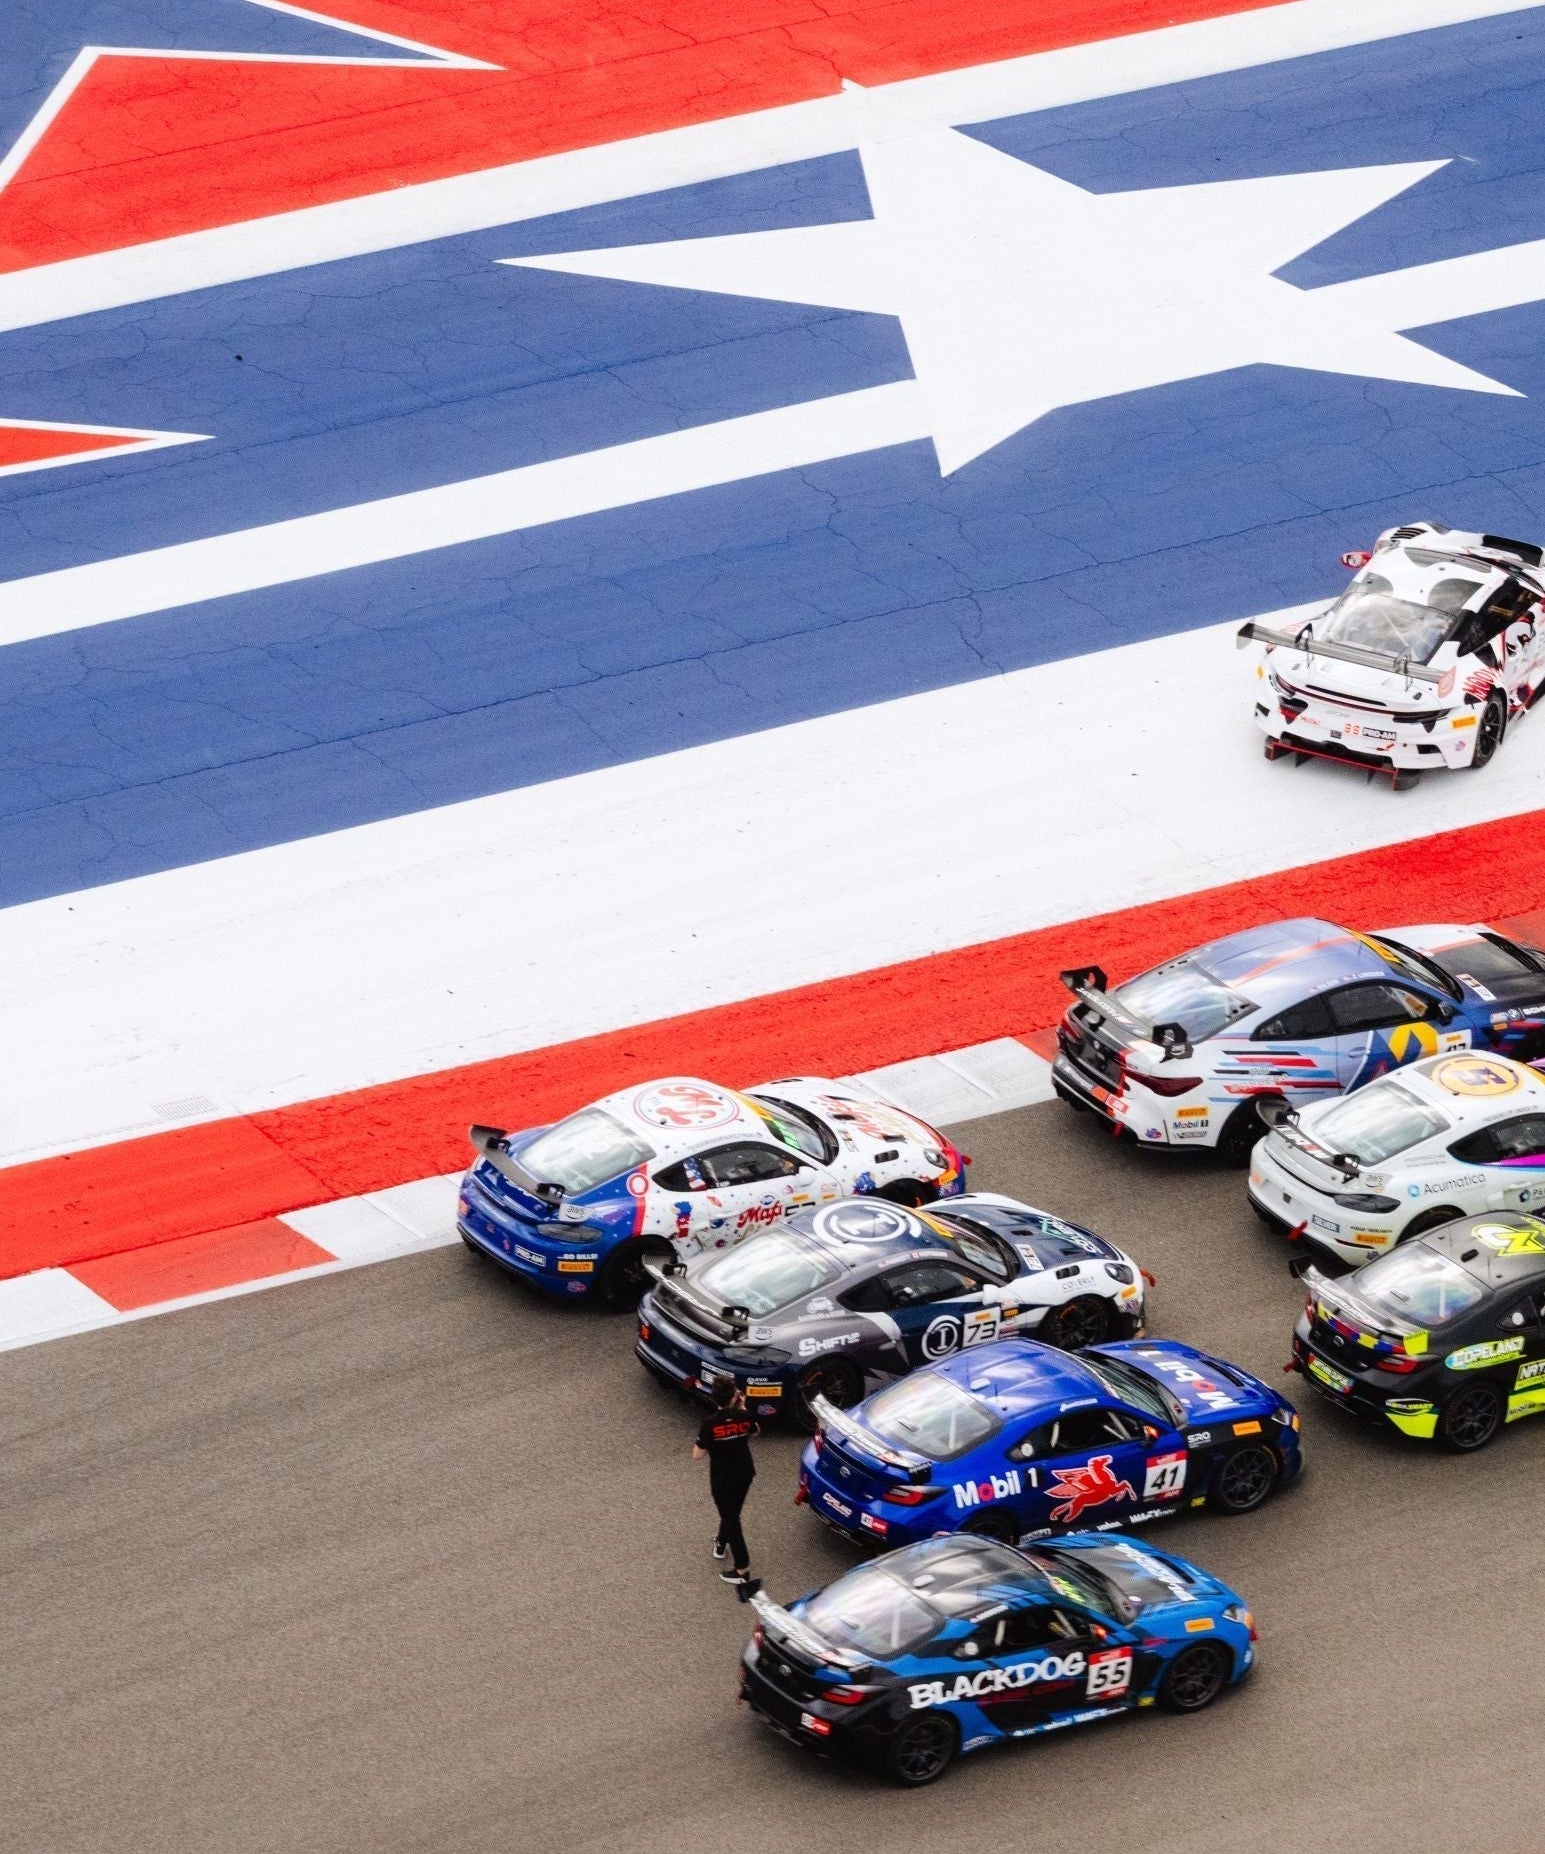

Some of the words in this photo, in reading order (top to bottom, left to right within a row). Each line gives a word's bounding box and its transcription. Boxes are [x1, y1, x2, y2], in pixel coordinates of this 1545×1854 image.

[1362, 727, 1397, 740] PRO-AM
[1173, 1120, 1199, 1130] Mobil
[1423, 1171, 1487, 1196] Acumatica
[966, 1320, 997, 1343] 73
[1154, 1359, 1242, 1410] Mobil
[712, 1421, 751, 1438] SRO
[1187, 1431, 1212, 1444] SRO
[952, 1469, 1022, 1509] Mobil
[1027, 1467, 1039, 1488] 1
[1150, 1466, 1180, 1490] 41
[906, 1651, 1087, 1710] BLACKDOG
[1092, 1660, 1127, 1690] 55
